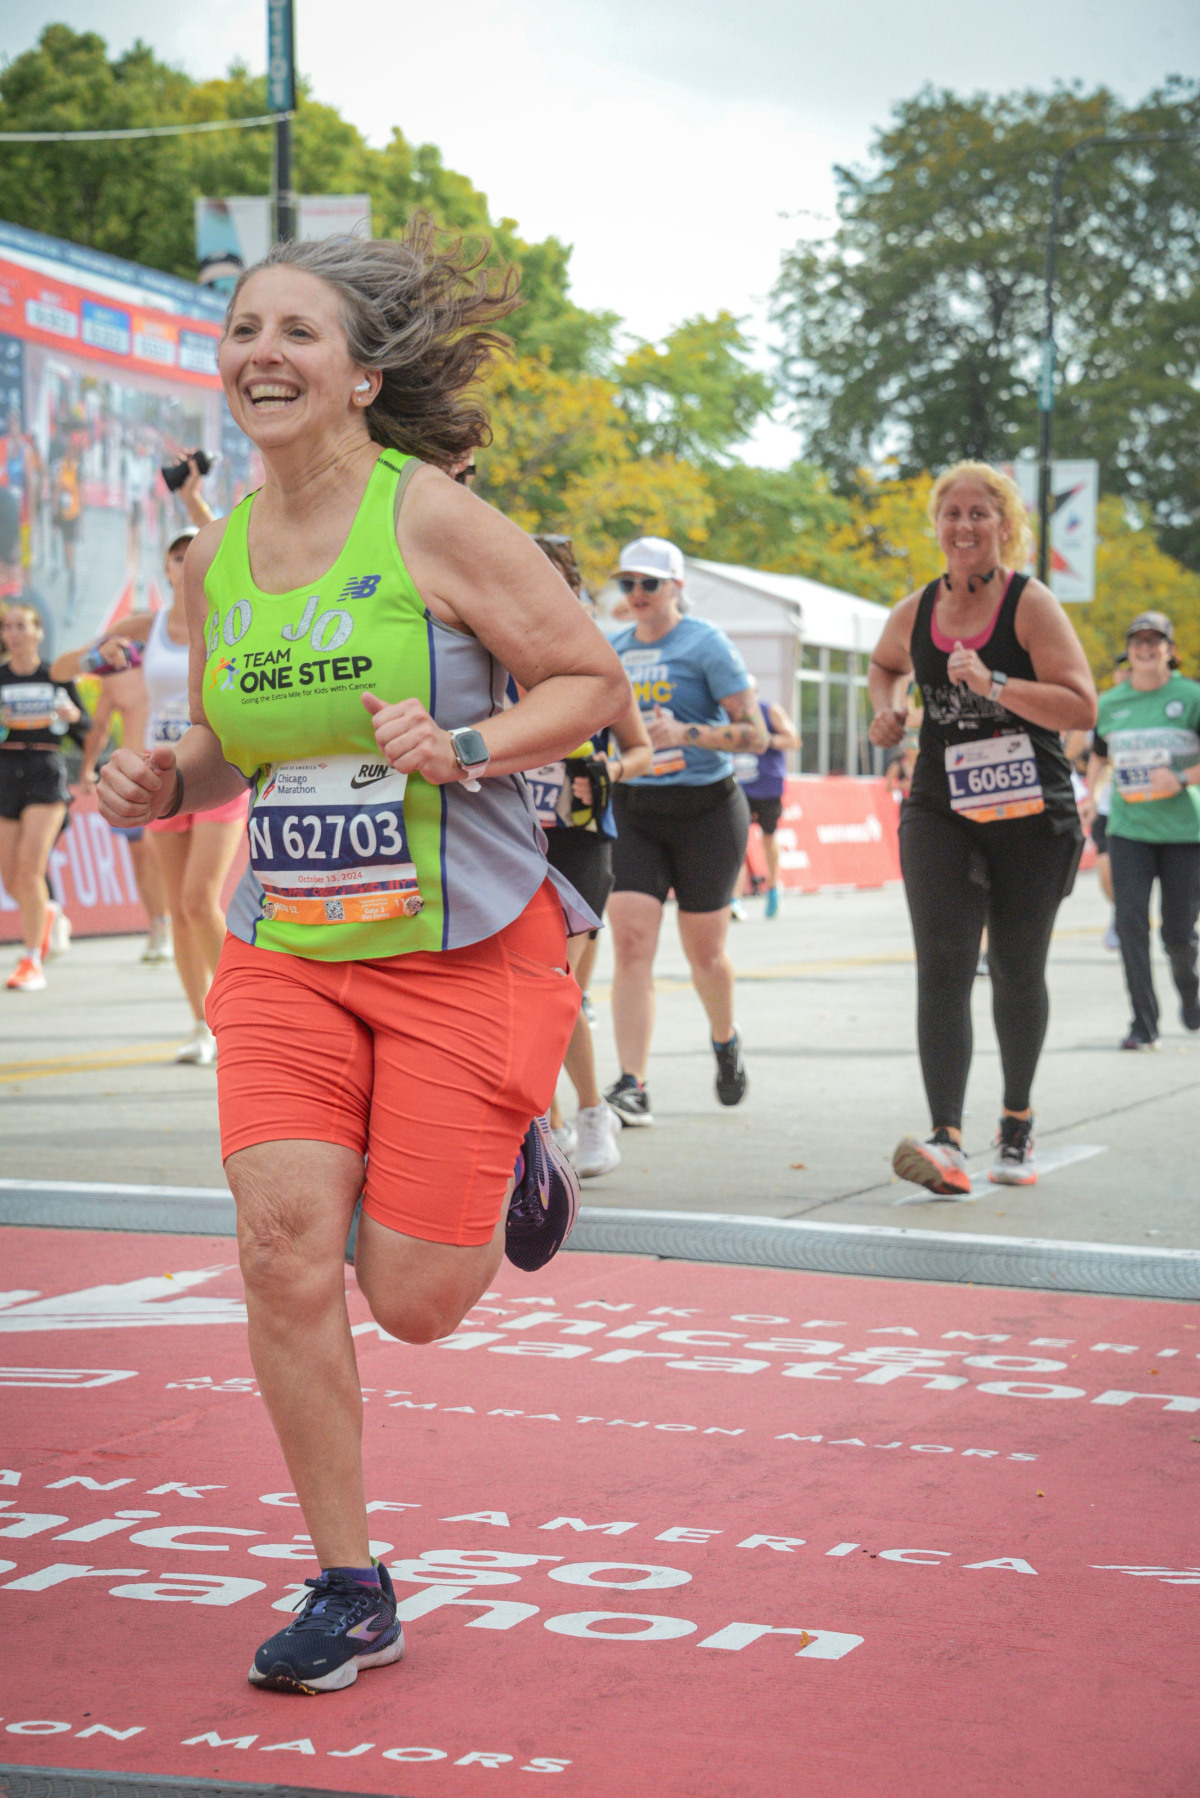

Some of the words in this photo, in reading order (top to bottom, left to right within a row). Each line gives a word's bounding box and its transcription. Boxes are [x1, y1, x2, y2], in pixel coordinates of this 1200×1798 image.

[281, 596, 354, 652] JO
[240, 666, 293, 693] ONE
[299, 656, 373, 685] STEP
[243, 648, 291, 668] TEAM
[241, 696, 259, 704] Going
[330, 684, 347, 692] with
[348, 682, 377, 691] Cancer
[277, 785, 316, 794] Marathon
[278, 773, 308, 785] Chicago
[358, 764, 389, 778] RUN
[948, 773, 966, 797] L
[968, 760, 1038, 794] 60659
[249, 816, 274, 860] N
[282, 811, 403, 860] 62703
[298, 875, 324, 883] October
[326, 874, 340, 882] 13,
[342, 871, 363, 881] 2024
[731, 1314, 849, 1328] OF
[867, 1325, 1200, 1359] AMERI
[389, 1400, 746, 1436] MARATHON
[774, 1432, 1040, 1462] MAJORS
[438, 1510, 1038, 1575] AMERICA
[181, 1730, 574, 1774] MAJORS
